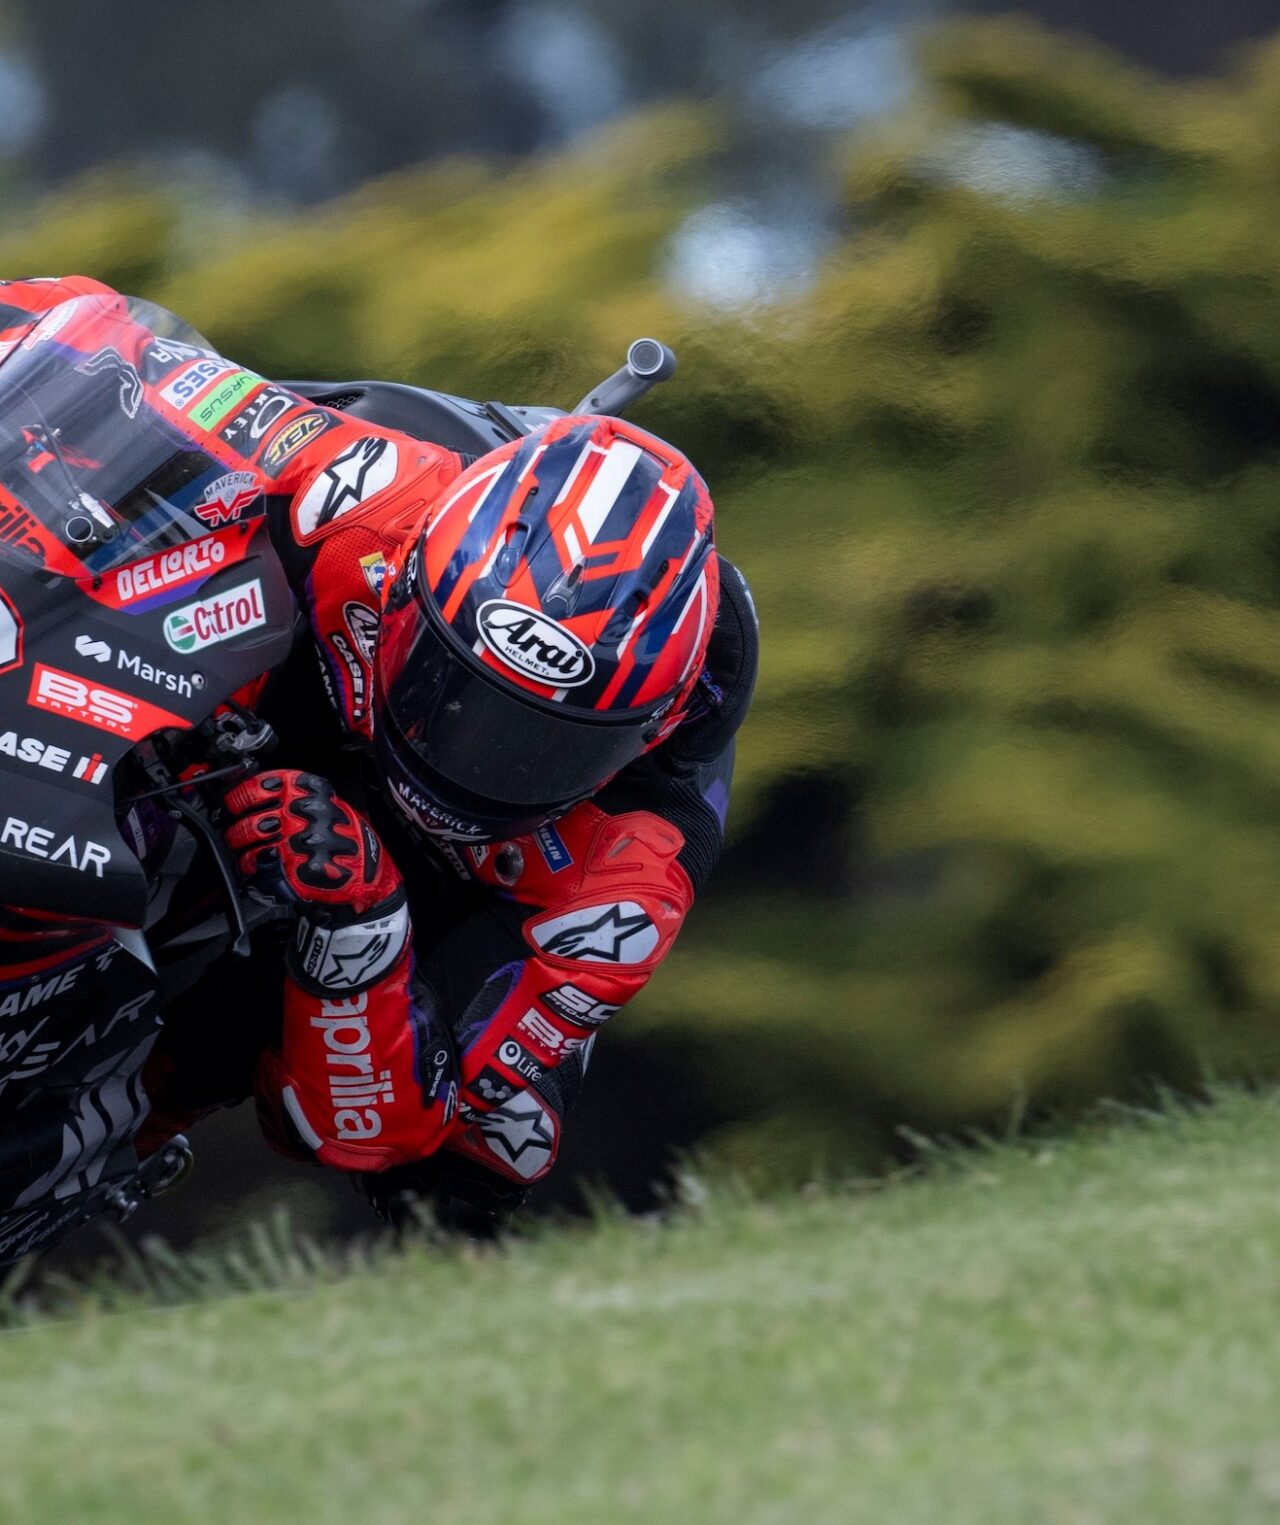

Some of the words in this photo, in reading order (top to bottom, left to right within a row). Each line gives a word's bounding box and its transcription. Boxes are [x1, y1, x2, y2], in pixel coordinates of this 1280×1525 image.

[200, 375, 252, 422] URSUS
[205, 473, 254, 498] MAVERICK
[117, 537, 225, 601] DELLORTO
[332, 634, 364, 694] CASE
[482, 617, 585, 674] Arai
[505, 646, 549, 676] HELMET
[37, 669, 133, 725] BS
[118, 650, 192, 698] Marsh
[36, 696, 131, 732] BATTERY
[398, 782, 483, 835] MAVERICK
[309, 992, 396, 1140] aprilia
[517, 1056, 543, 1083] Life
